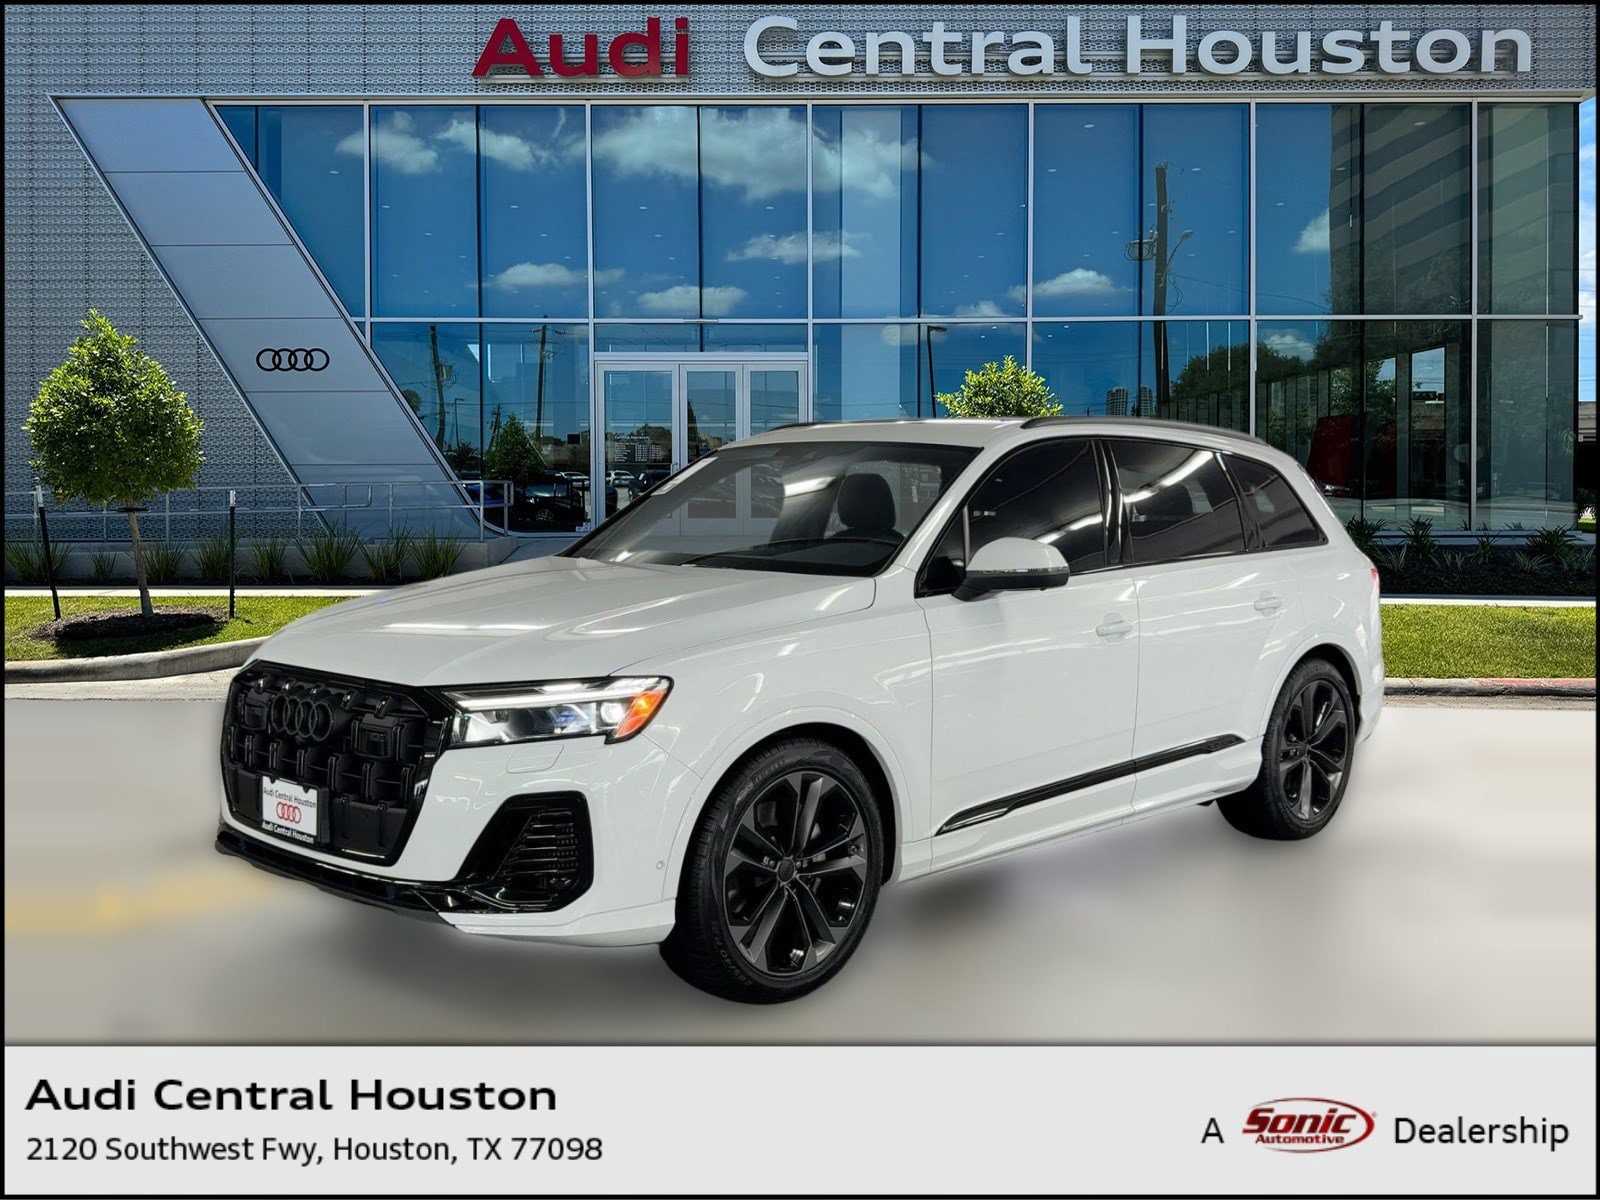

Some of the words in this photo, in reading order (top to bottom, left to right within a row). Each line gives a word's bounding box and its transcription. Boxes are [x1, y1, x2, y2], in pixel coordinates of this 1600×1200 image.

[471, 16, 690, 78] Audi
[743, 15, 1092, 77] Central
[1126, 15, 1532, 75] Houston
[263, 787, 274, 797] Audi
[275, 789, 293, 803] Central
[293, 794, 317, 809] Houston
[261, 820, 274, 831] Audi
[273, 824, 293, 838] Central
[292, 828, 314, 844] Houston
